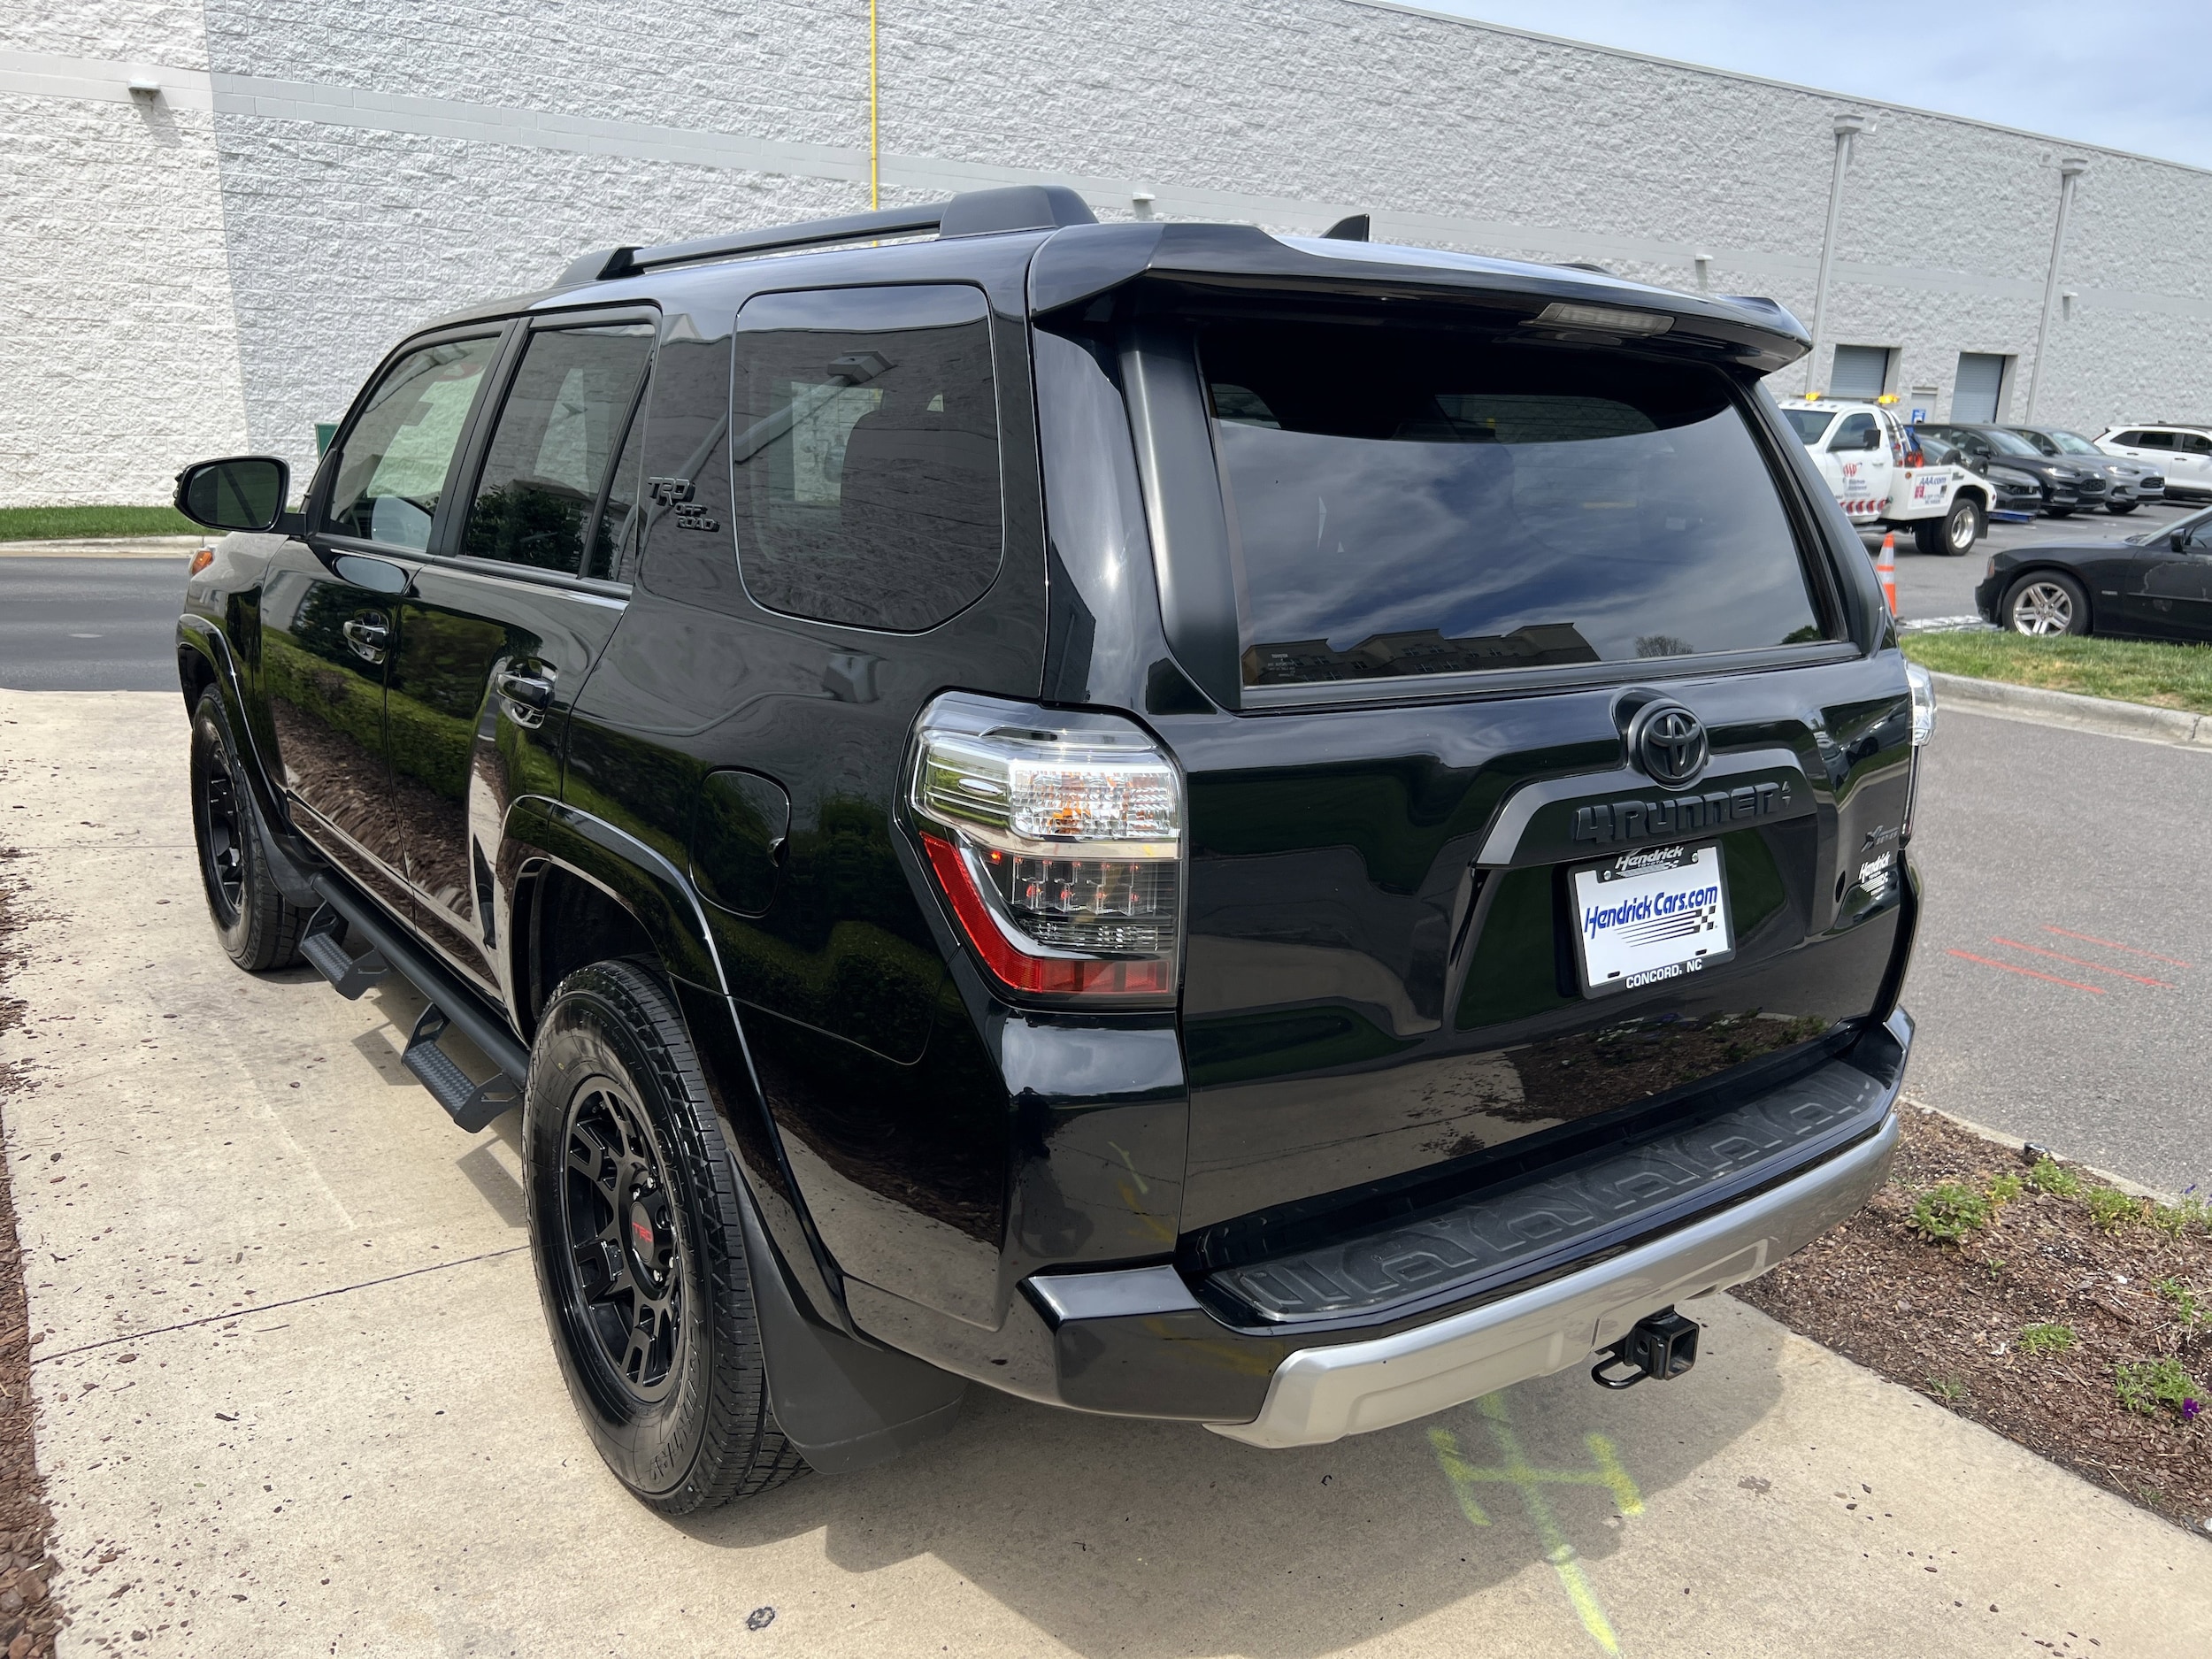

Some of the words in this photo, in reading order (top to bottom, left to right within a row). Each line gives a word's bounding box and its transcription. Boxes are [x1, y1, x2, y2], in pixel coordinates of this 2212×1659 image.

[648, 476, 693, 507] TRD
[674, 503, 705, 516] OFF
[677, 516, 718, 531] ROAD
[1615, 845, 1685, 871] Hendrick
[1625, 964, 1683, 989] CONCORD,
[1686, 958, 1702, 972] NC
[632, 1221, 653, 1243] TRD
